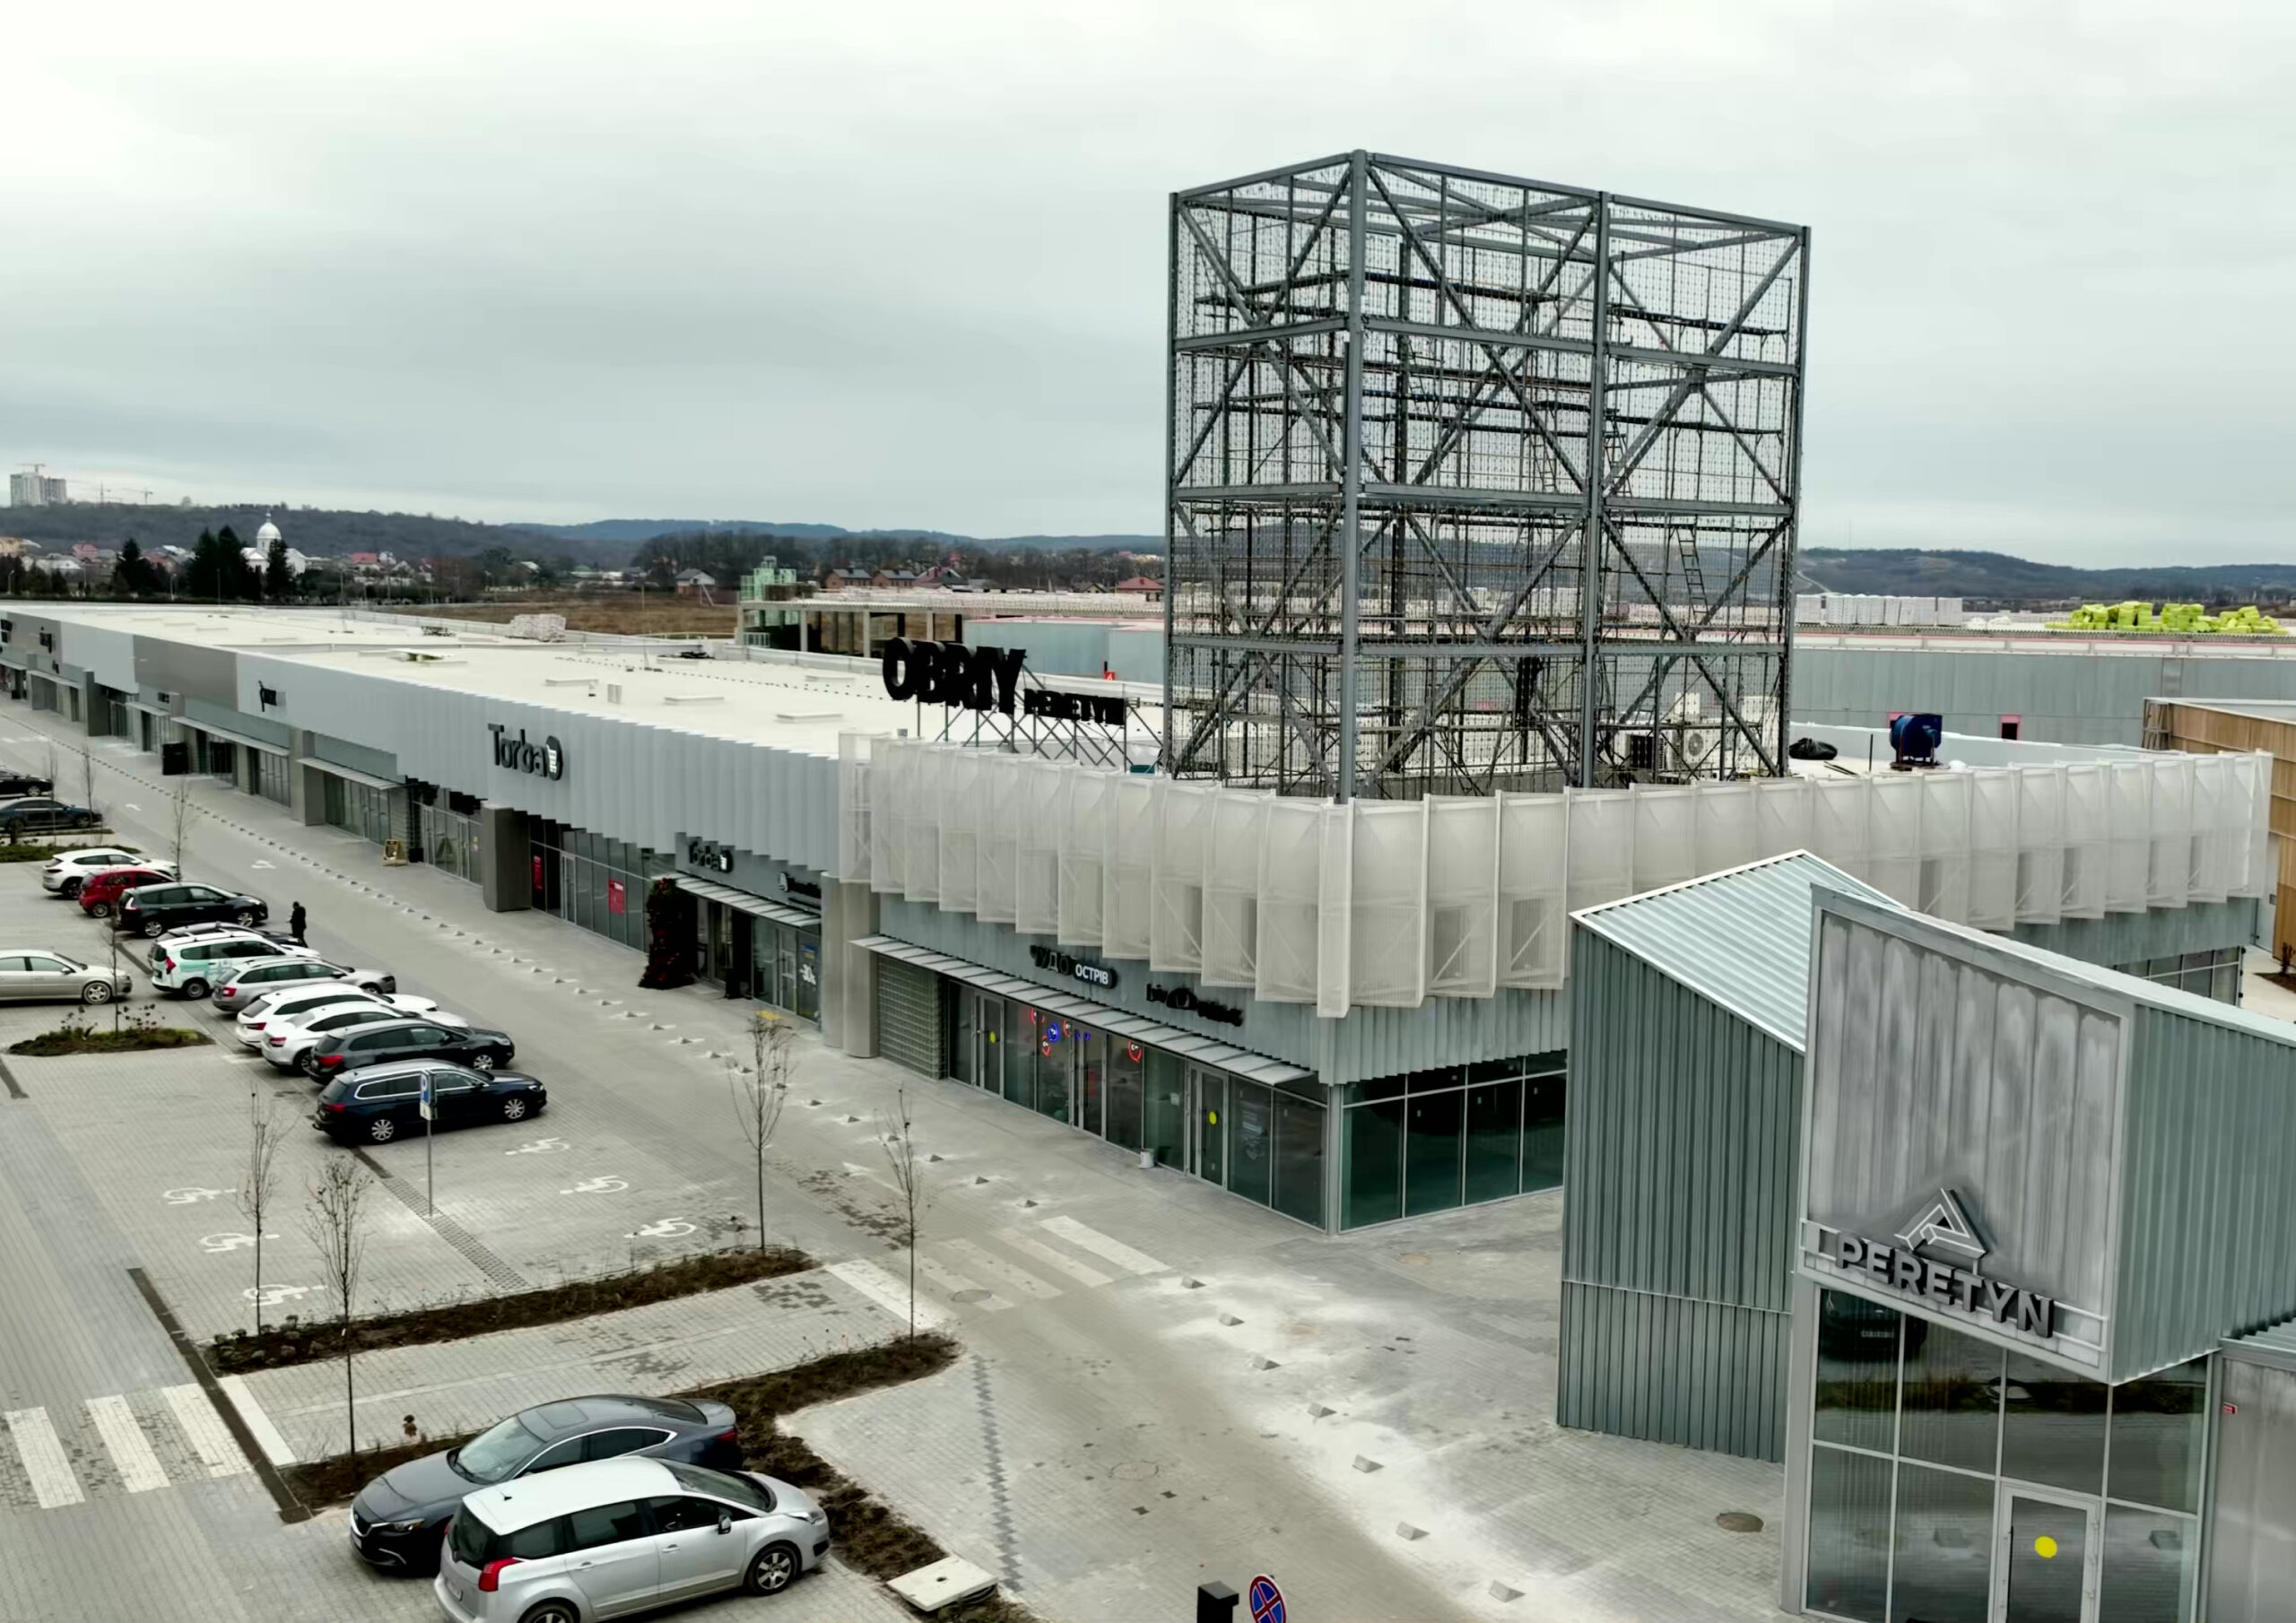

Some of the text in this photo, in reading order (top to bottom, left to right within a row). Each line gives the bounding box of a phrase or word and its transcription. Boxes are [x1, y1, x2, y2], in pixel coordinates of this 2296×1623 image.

[488, 723, 547, 777] Torba
[1075, 964, 1109, 985] ОСТРІВ
[1836, 1233, 2054, 1339] PERETYN
